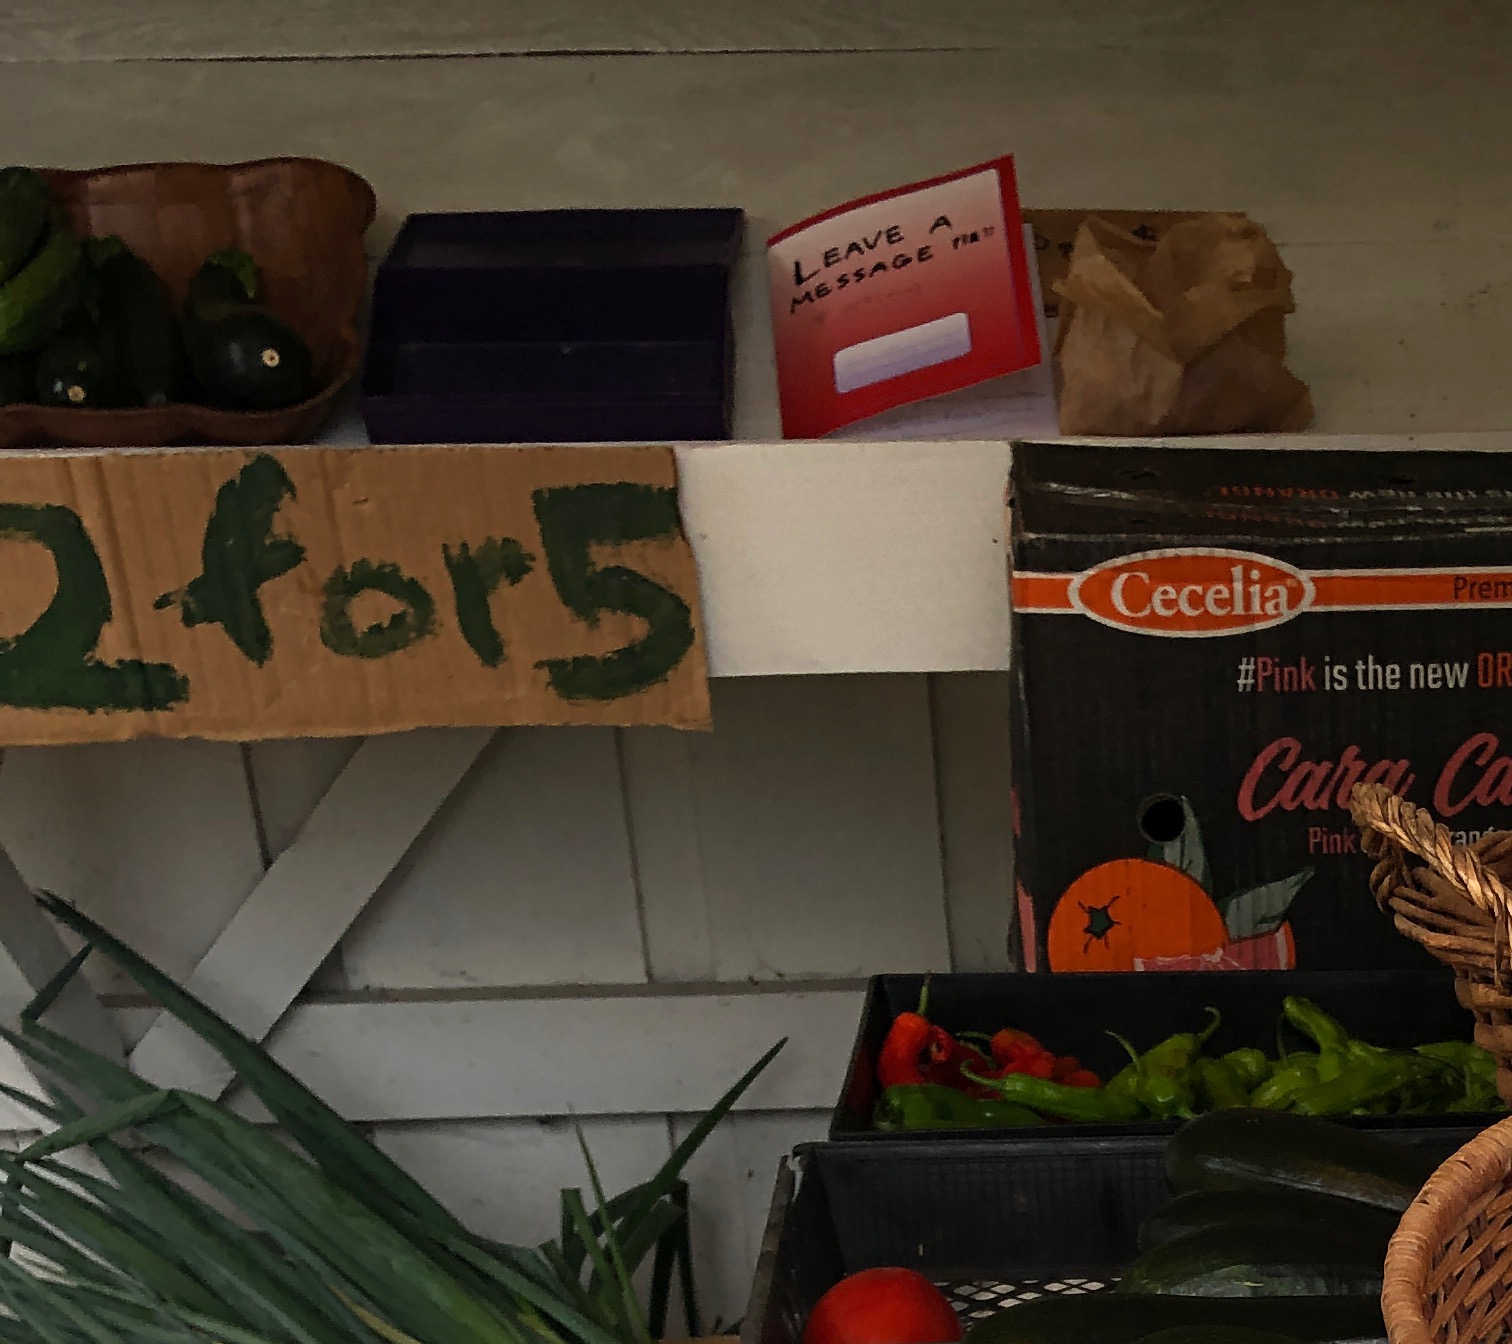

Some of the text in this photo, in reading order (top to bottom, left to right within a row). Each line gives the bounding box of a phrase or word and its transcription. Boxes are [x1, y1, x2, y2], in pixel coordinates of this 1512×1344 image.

[789, 245, 934, 314] MESSAGE
[793, 225, 904, 286] LEAVE
[929, 214, 952, 235] A
[0, 502, 190, 714] 2
[1111, 564, 1293, 618] Cecelia
[1236, 655, 1318, 693] #Pink
[1322, 655, 1348, 692] is
[1355, 654, 1401, 691] the
[1409, 661, 1470, 691] new
[1237, 736, 1418, 823] Cara
[1308, 826, 1360, 854] Pink
